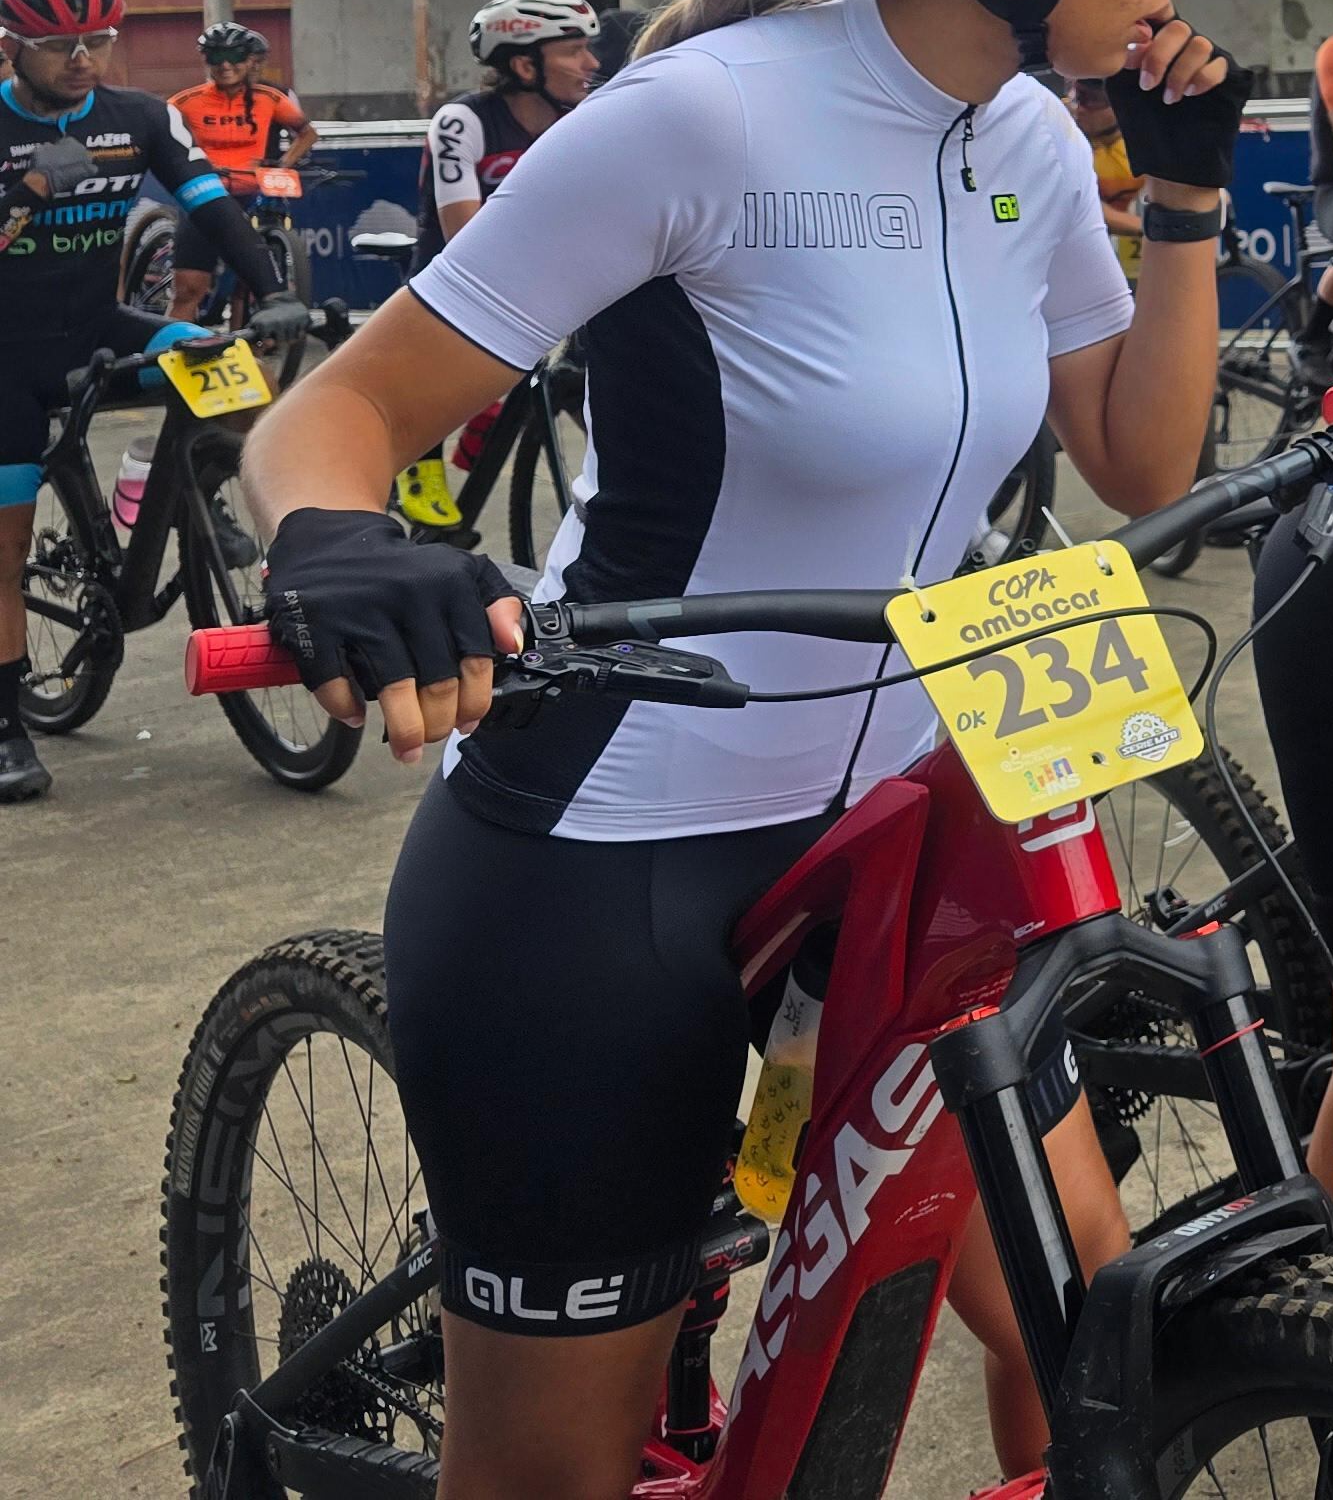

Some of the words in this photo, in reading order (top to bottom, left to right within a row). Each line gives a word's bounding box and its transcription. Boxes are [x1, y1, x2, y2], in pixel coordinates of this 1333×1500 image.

[86, 133, 131, 148] LAZER
[439, 115, 464, 184] CMS
[191, 363, 249, 393] 215
[988, 567, 1058, 607] COPA
[960, 588, 1102, 644] ambacar
[966, 619, 1150, 740] 234
[716, 1042, 945, 1448] ASGAS
